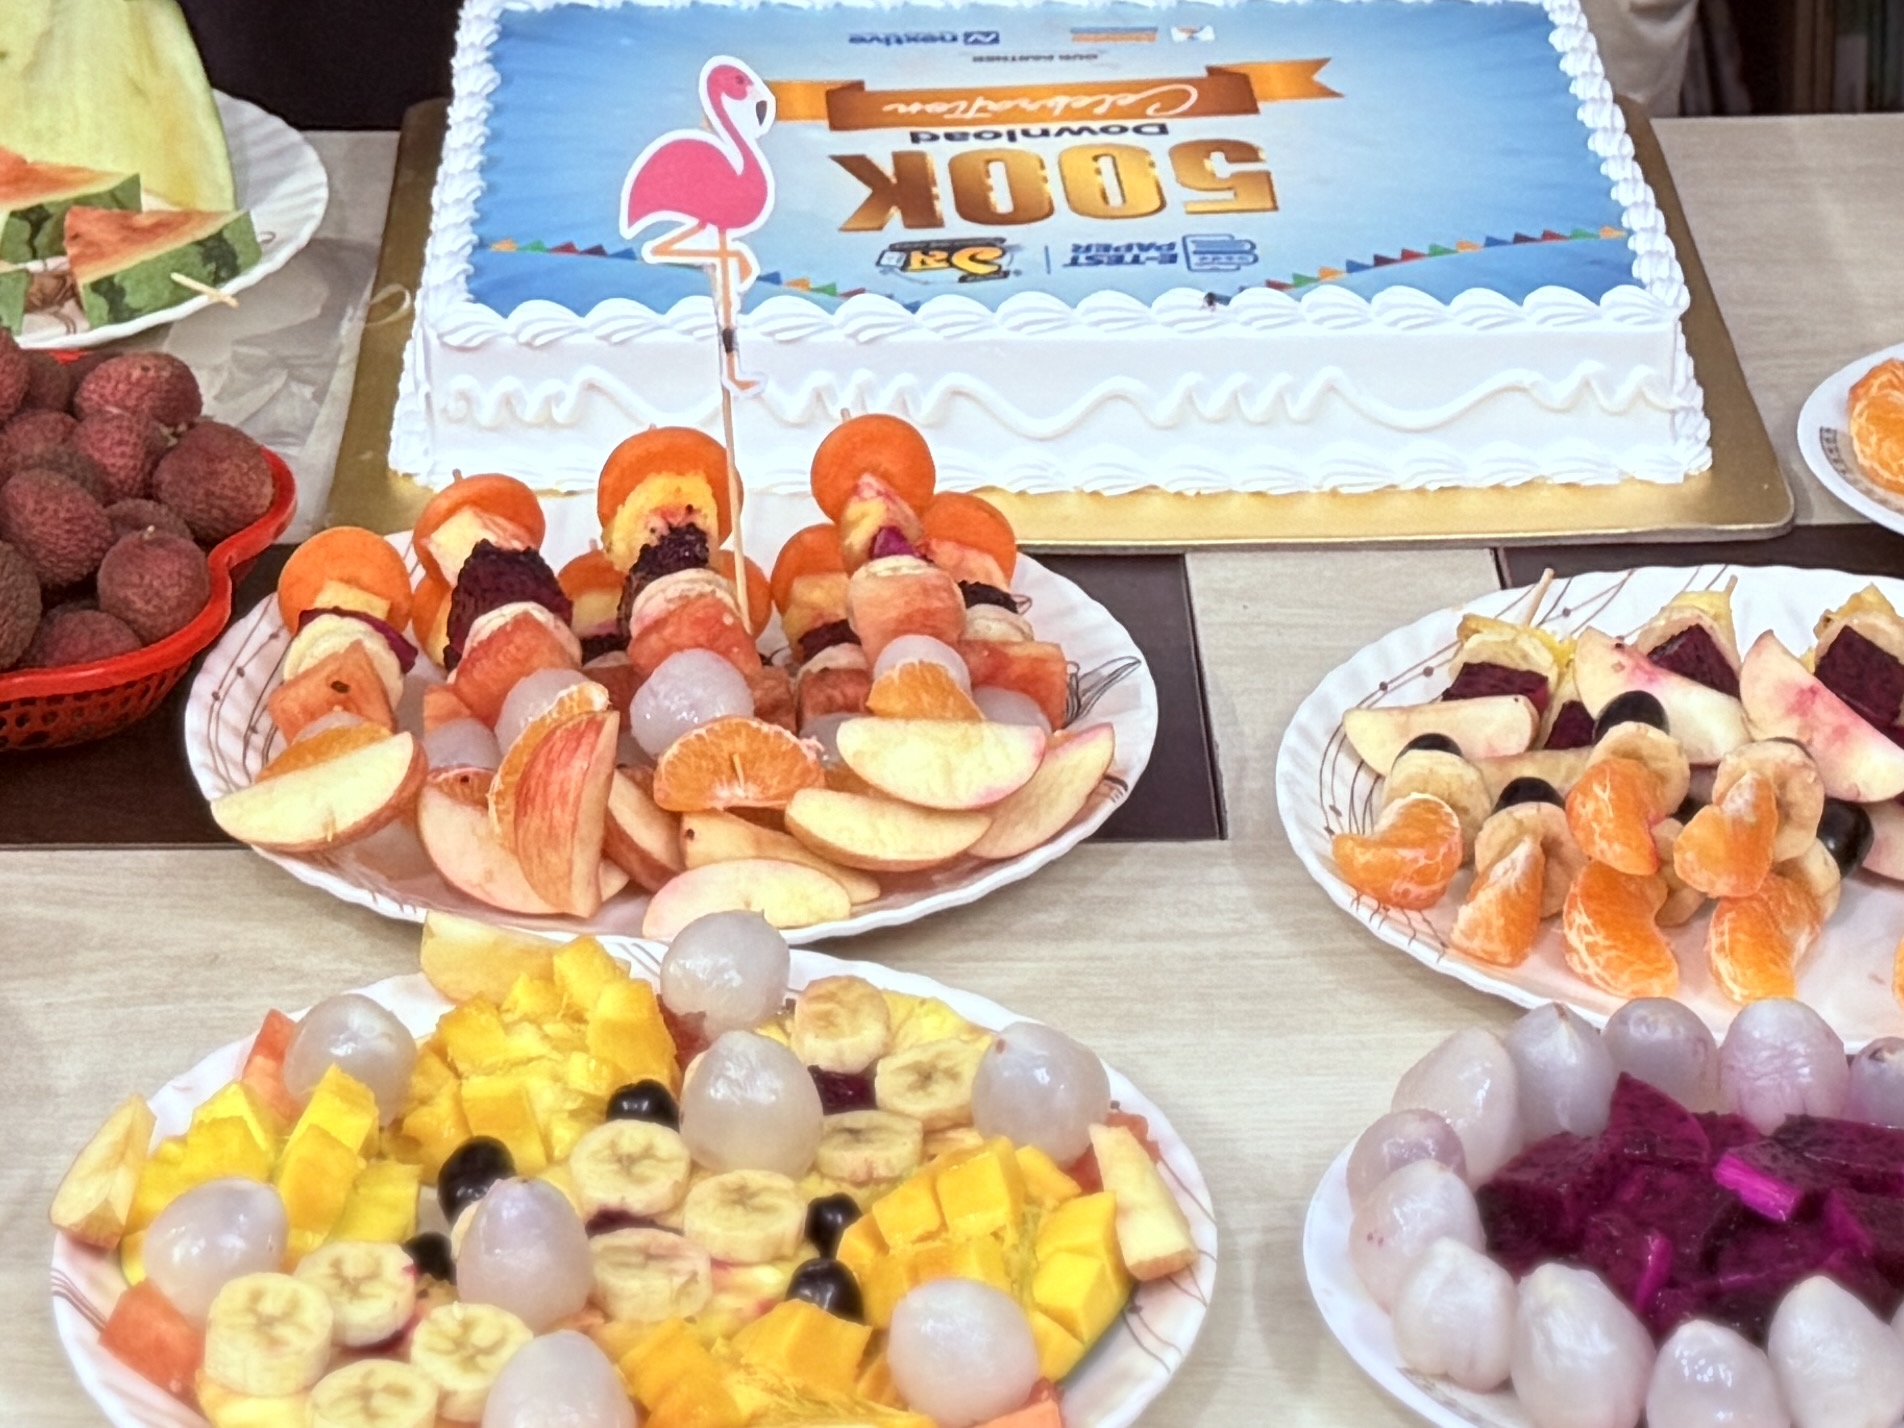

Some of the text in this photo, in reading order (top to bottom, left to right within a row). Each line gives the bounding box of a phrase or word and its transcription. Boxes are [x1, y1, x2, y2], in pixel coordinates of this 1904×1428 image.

[848, 30, 958, 46] nextive
[882, 84, 1197, 120] Celebration
[909, 122, 1169, 144] Download
[830, 138, 1279, 231] 500K
[1070, 242, 1176, 256] PAPER
